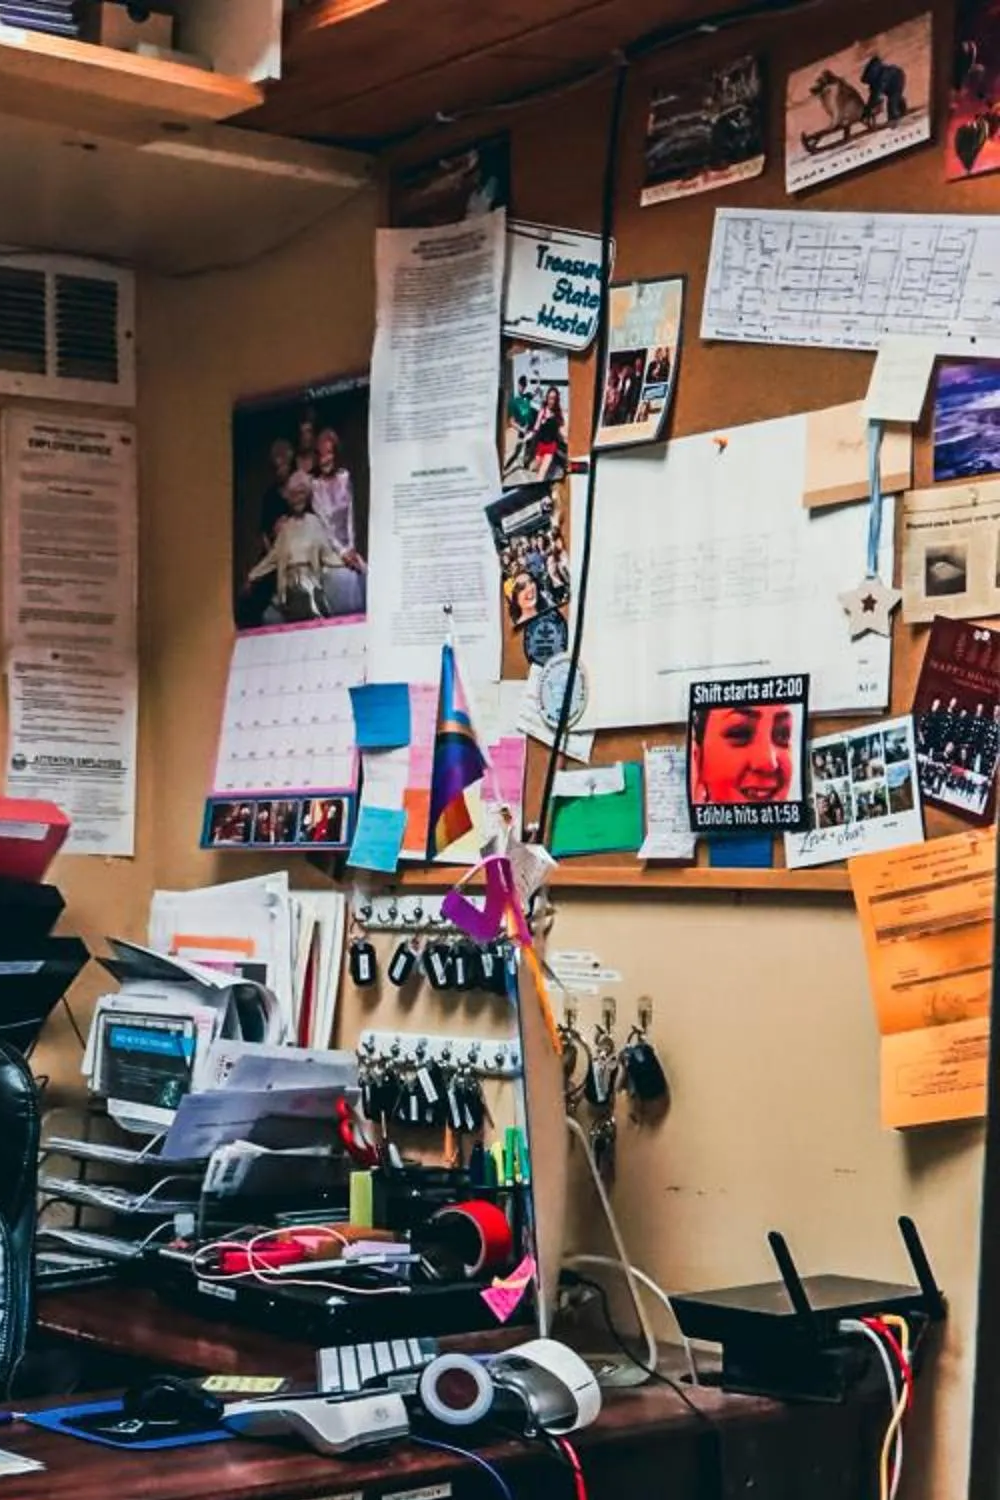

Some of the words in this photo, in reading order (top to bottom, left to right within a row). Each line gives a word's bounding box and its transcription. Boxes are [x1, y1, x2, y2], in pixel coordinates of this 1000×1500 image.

[536, 244, 603, 279] Treasure
[553, 278, 600, 309] State
[537, 304, 593, 336] Hostel
[694, 684, 722, 703] Shift
[723, 683, 759, 700] starts
[761, 683, 775, 698] at
[776, 678, 803, 697] 2:00
[697, 806, 733, 825] Edible
[734, 806, 758, 824] hits
[760, 807, 774, 823] at
[774, 805, 799, 823] 1:58
